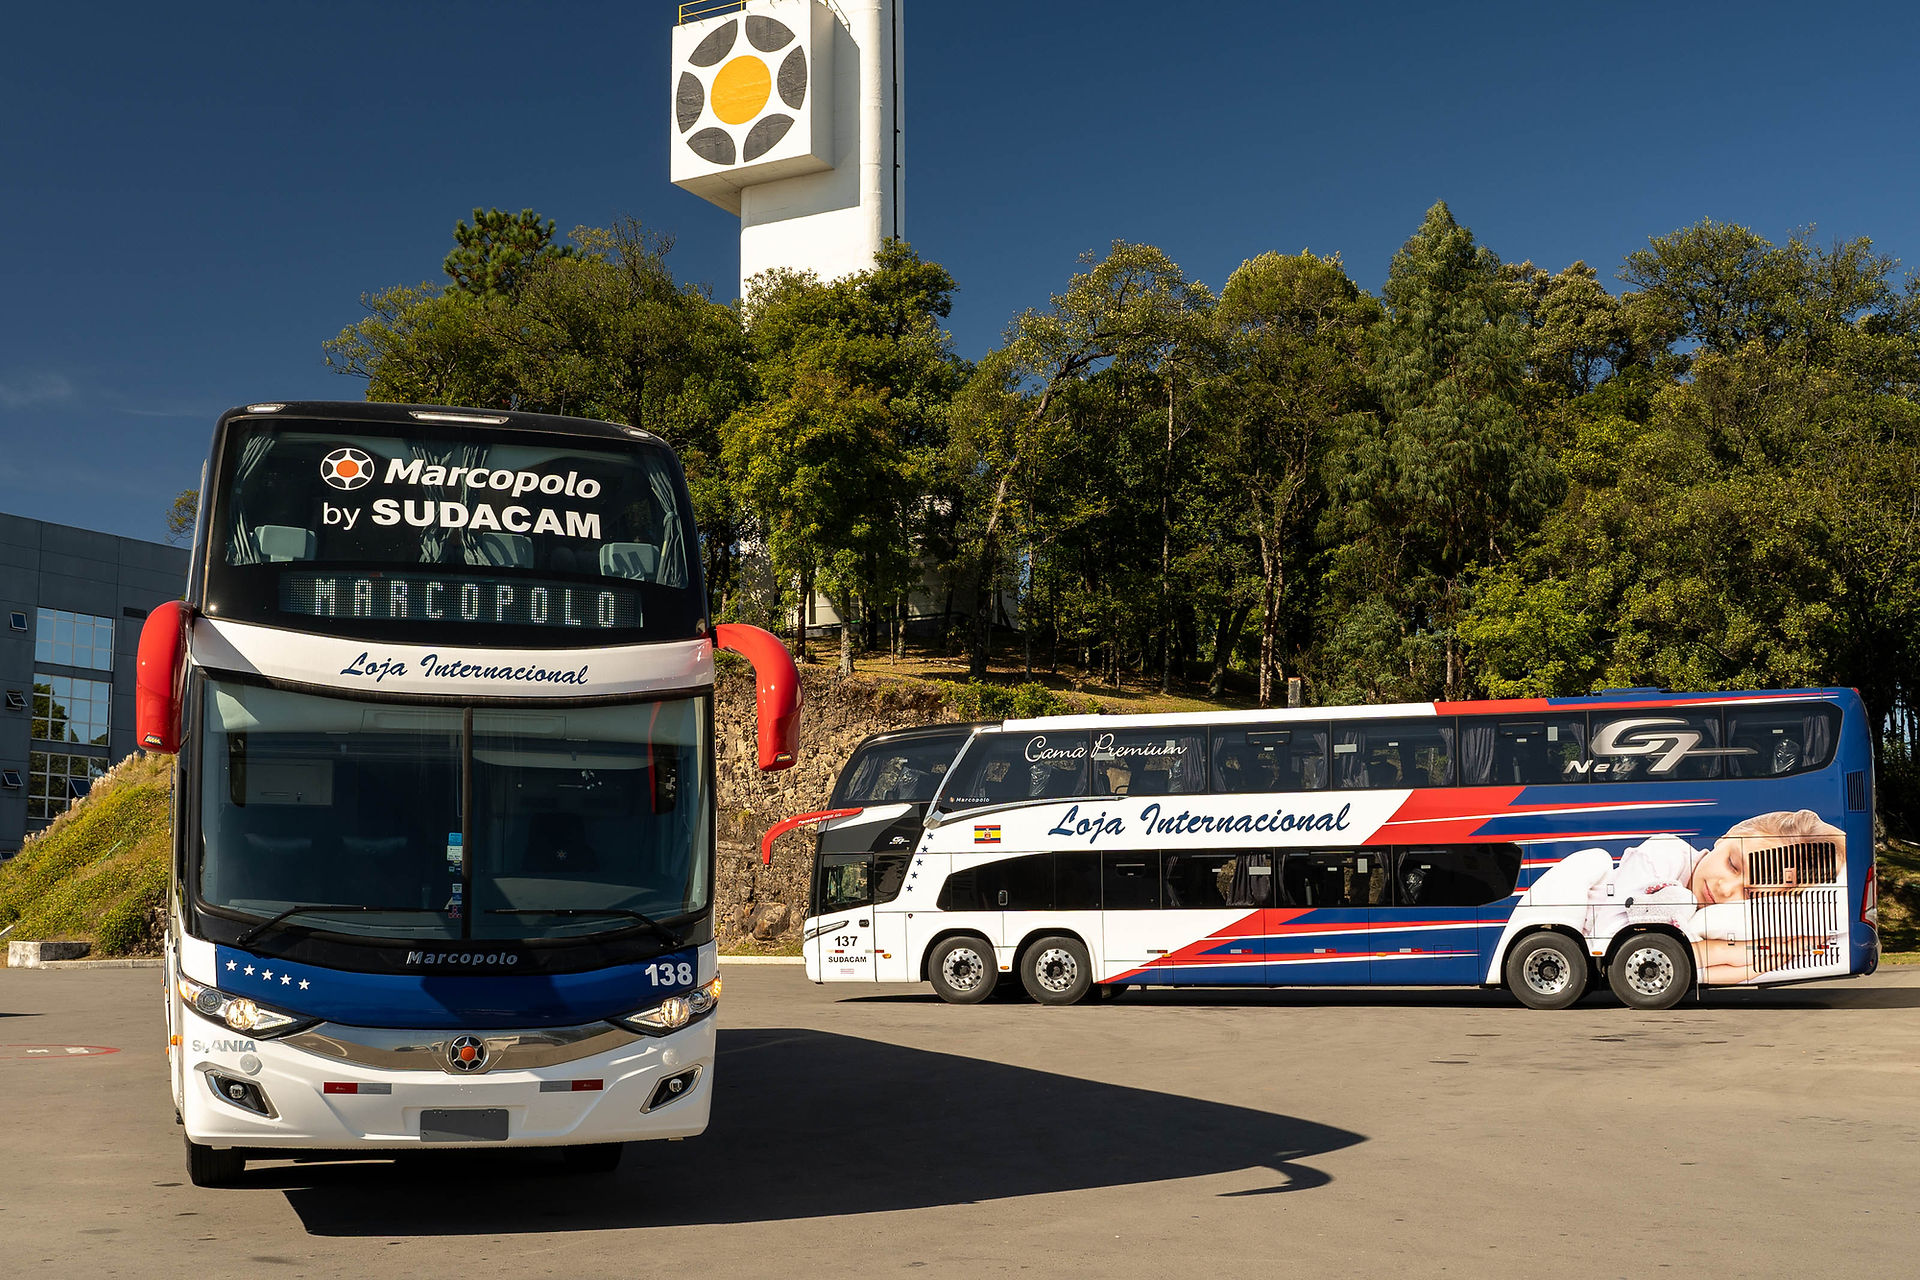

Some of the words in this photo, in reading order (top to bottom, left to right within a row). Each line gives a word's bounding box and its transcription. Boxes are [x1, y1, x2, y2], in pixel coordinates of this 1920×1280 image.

[383, 458, 601, 498] Marcopolo
[323, 502, 361, 531] by
[371, 498, 601, 540] SUDACAM
[315, 578, 615, 628] MARCOPOLO
[340, 651, 408, 683] Loja
[420, 653, 589, 685] Internacional
[1024, 735, 1088, 763] Cama
[1091, 733, 1187, 761] Premium
[1563, 759, 1639, 774] New
[1048, 804, 1125, 845] Loja
[1140, 802, 1351, 837] Internacional
[834, 935, 858, 947] 137
[406, 951, 518, 966] Marcopolo
[828, 955, 867, 963] SUDACAM
[644, 962, 694, 987] 138
